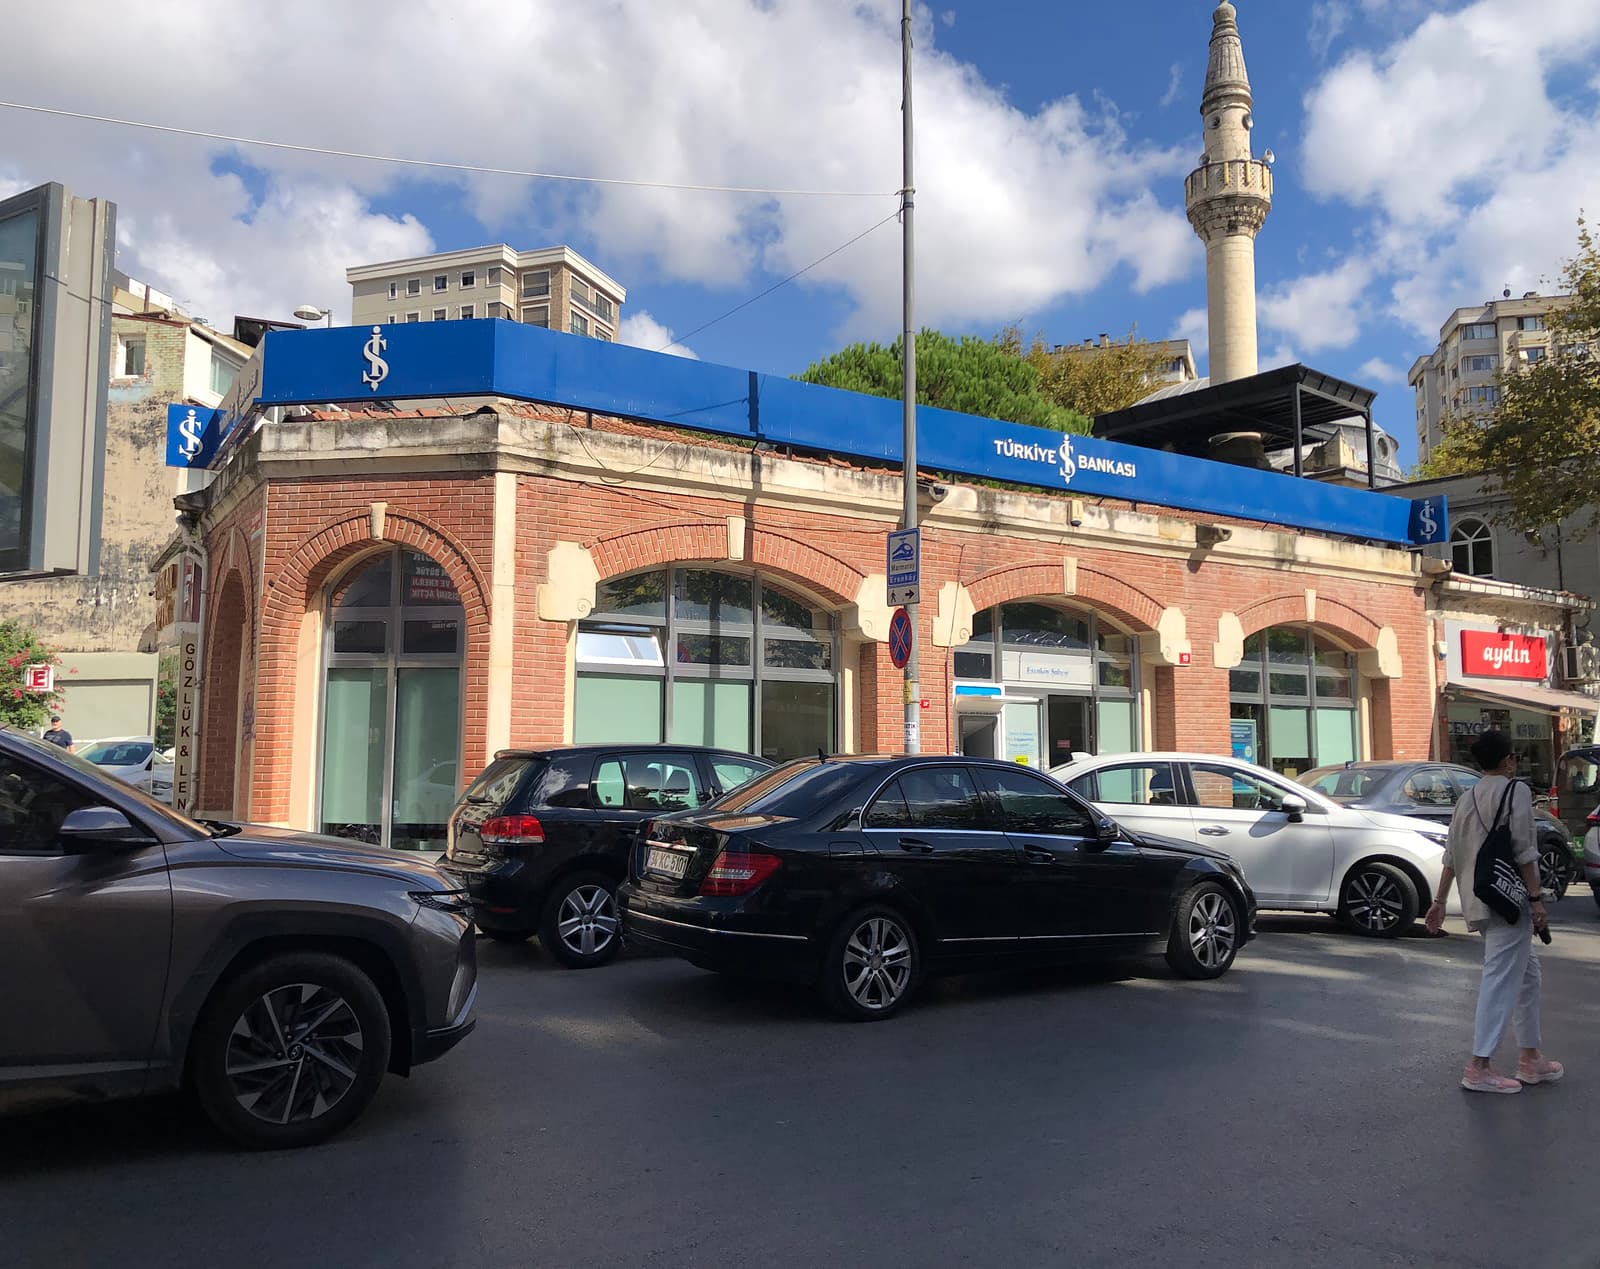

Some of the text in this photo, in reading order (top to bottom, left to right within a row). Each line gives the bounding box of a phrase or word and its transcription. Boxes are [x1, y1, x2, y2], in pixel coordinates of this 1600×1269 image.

[993, 438, 1057, 465] TÜRKİYE
[1078, 454, 1136, 478] BANKASI
[1483, 640, 1531, 669] aydın
[33, 670, 46, 686] E
[181, 643, 195, 738] GÖZLÜK
[180, 746, 189, 757] &
